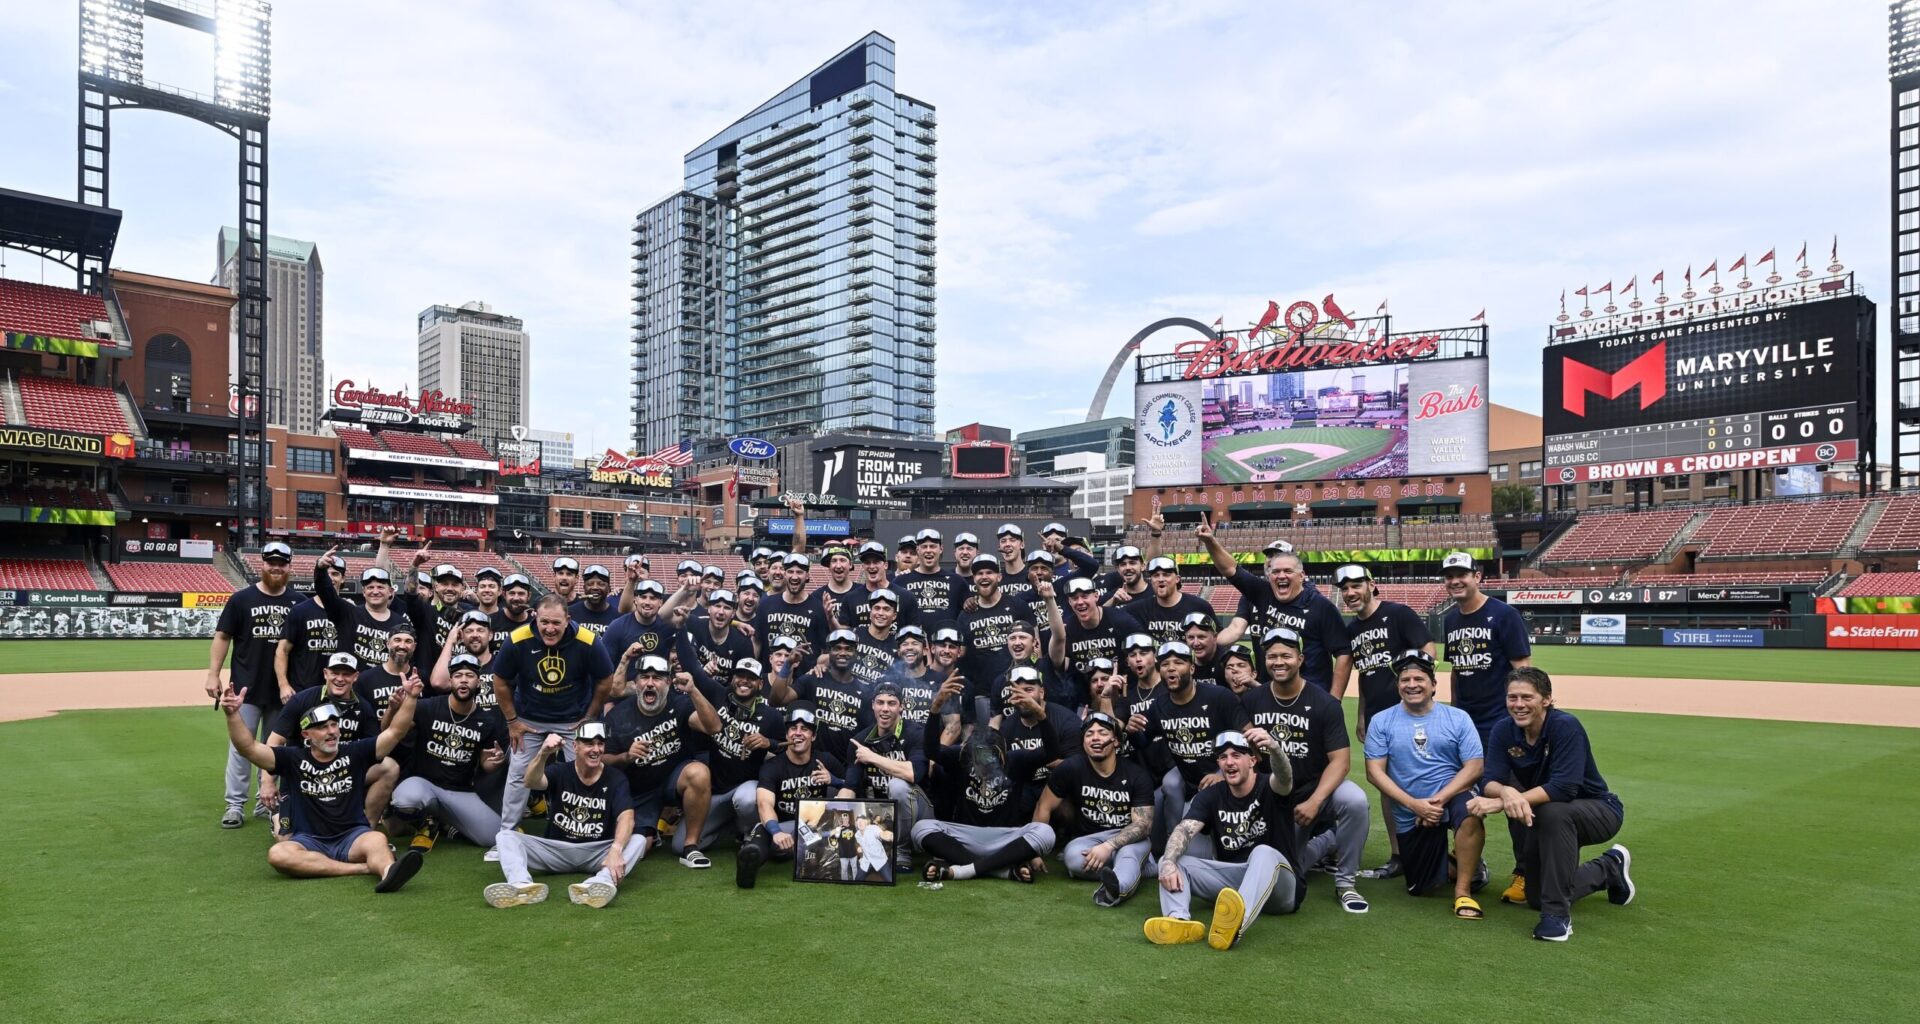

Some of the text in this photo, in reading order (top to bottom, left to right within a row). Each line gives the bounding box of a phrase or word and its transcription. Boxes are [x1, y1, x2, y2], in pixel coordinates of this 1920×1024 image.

[1574, 283, 1820, 335] WORLD CHAMPIONS
[1599, 312, 1787, 349] TODAY'S GAME PRESENTED BY:
[1175, 334, 1440, 380] Budweiser
[1676, 337, 1834, 377] MARYVILLE
[1677, 362, 1832, 392] UNIVERSITY
[334, 379, 474, 416] Cardinals Nation
[1448, 384, 1465, 396] The
[1142, 401, 1153, 417] LOUIS
[1152, 392, 1186, 403] COMMUNITY
[1184, 400, 1196, 424] COLLEGE
[1414, 384, 1483, 421] Bash
[360, 410, 404, 422] HOFFMANN
[1768, 407, 1845, 421] BALLS STRIKES OUTS
[419, 417, 461, 429] ROOFTOP
[1772, 418, 1844, 440] 0 0 0
[0, 430, 101, 453] MAC LAND
[1144, 429, 1192, 447] ARCHERS
[1430, 436, 1466, 445] WABASH
[1548, 424, 1751, 453] WABASH VALLEY 0 0 0
[739, 440, 768, 456] Ford
[1432, 445, 1464, 454] VALLEY
[1548, 437, 1751, 465] ST. LOUIS CC 0 0 0
[1819, 448, 1834, 456] BC
[1430, 454, 1465, 463] COLLEGE
[1589, 448, 1797, 480] BROWN & CROUPPEN
[857, 459, 922, 475] FROM THE
[1562, 470, 1574, 479] BC
[592, 471, 673, 488] BREW HOUSE
[857, 471, 913, 486] LOU AND
[857, 484, 890, 498] WE'R
[1172, 483, 1445, 505] 1 2 6 9 10 14 17 20 23 24 42 45 85
[771, 522, 794, 531] SCOTT
[823, 524, 847, 532] UNION
[144, 542, 154, 551] GO
[156, 543, 166, 551] GO
[167, 543, 178, 552] GO
[907, 580, 950, 591] DIVISION
[45, 594, 106, 604] Central Bank
[197, 594, 230, 603] DOBB
[1512, 591, 1575, 600] Schnucks
[1608, 590, 1678, 601] 4:29 87°
[1698, 592, 1721, 600] Mercy
[251, 605, 291, 617] DIVISIO
[768, 613, 811, 628] DIVISION
[970, 615, 1013, 631] DIVISION
[1148, 620, 1185, 632] DIVISIO
[1592, 618, 1614, 627] Ford
[973, 634, 1008, 647] CHAMP
[1351, 628, 1389, 650] DIVISION
[1448, 627, 1491, 644] DIVISION
[1673, 632, 1713, 644] STIFEL
[307, 639, 338, 649] CHAM
[1072, 638, 1116, 653] DIVISION
[852, 664, 885, 680] HAMP
[816, 687, 862, 709] DIVISION
[816, 708, 858, 727] CHAMPS
[1161, 716, 1210, 730] DIVISION
[1254, 712, 1310, 730] DIVISION
[432, 720, 481, 742] DIVISION
[634, 718, 678, 743] DIVISION
[426, 740, 473, 759] CHAMPS
[1168, 740, 1212, 755] CHAMPS
[300, 755, 350, 776] DIVISION
[300, 776, 353, 794] CHAMPS
[781, 776, 822, 791] DIVISIO
[561, 791, 606, 811] DIVISION
[1081, 785, 1130, 802] DIVISION
[554, 812, 604, 834] CHAMPS
[1080, 807, 1132, 825] CHAMPS
